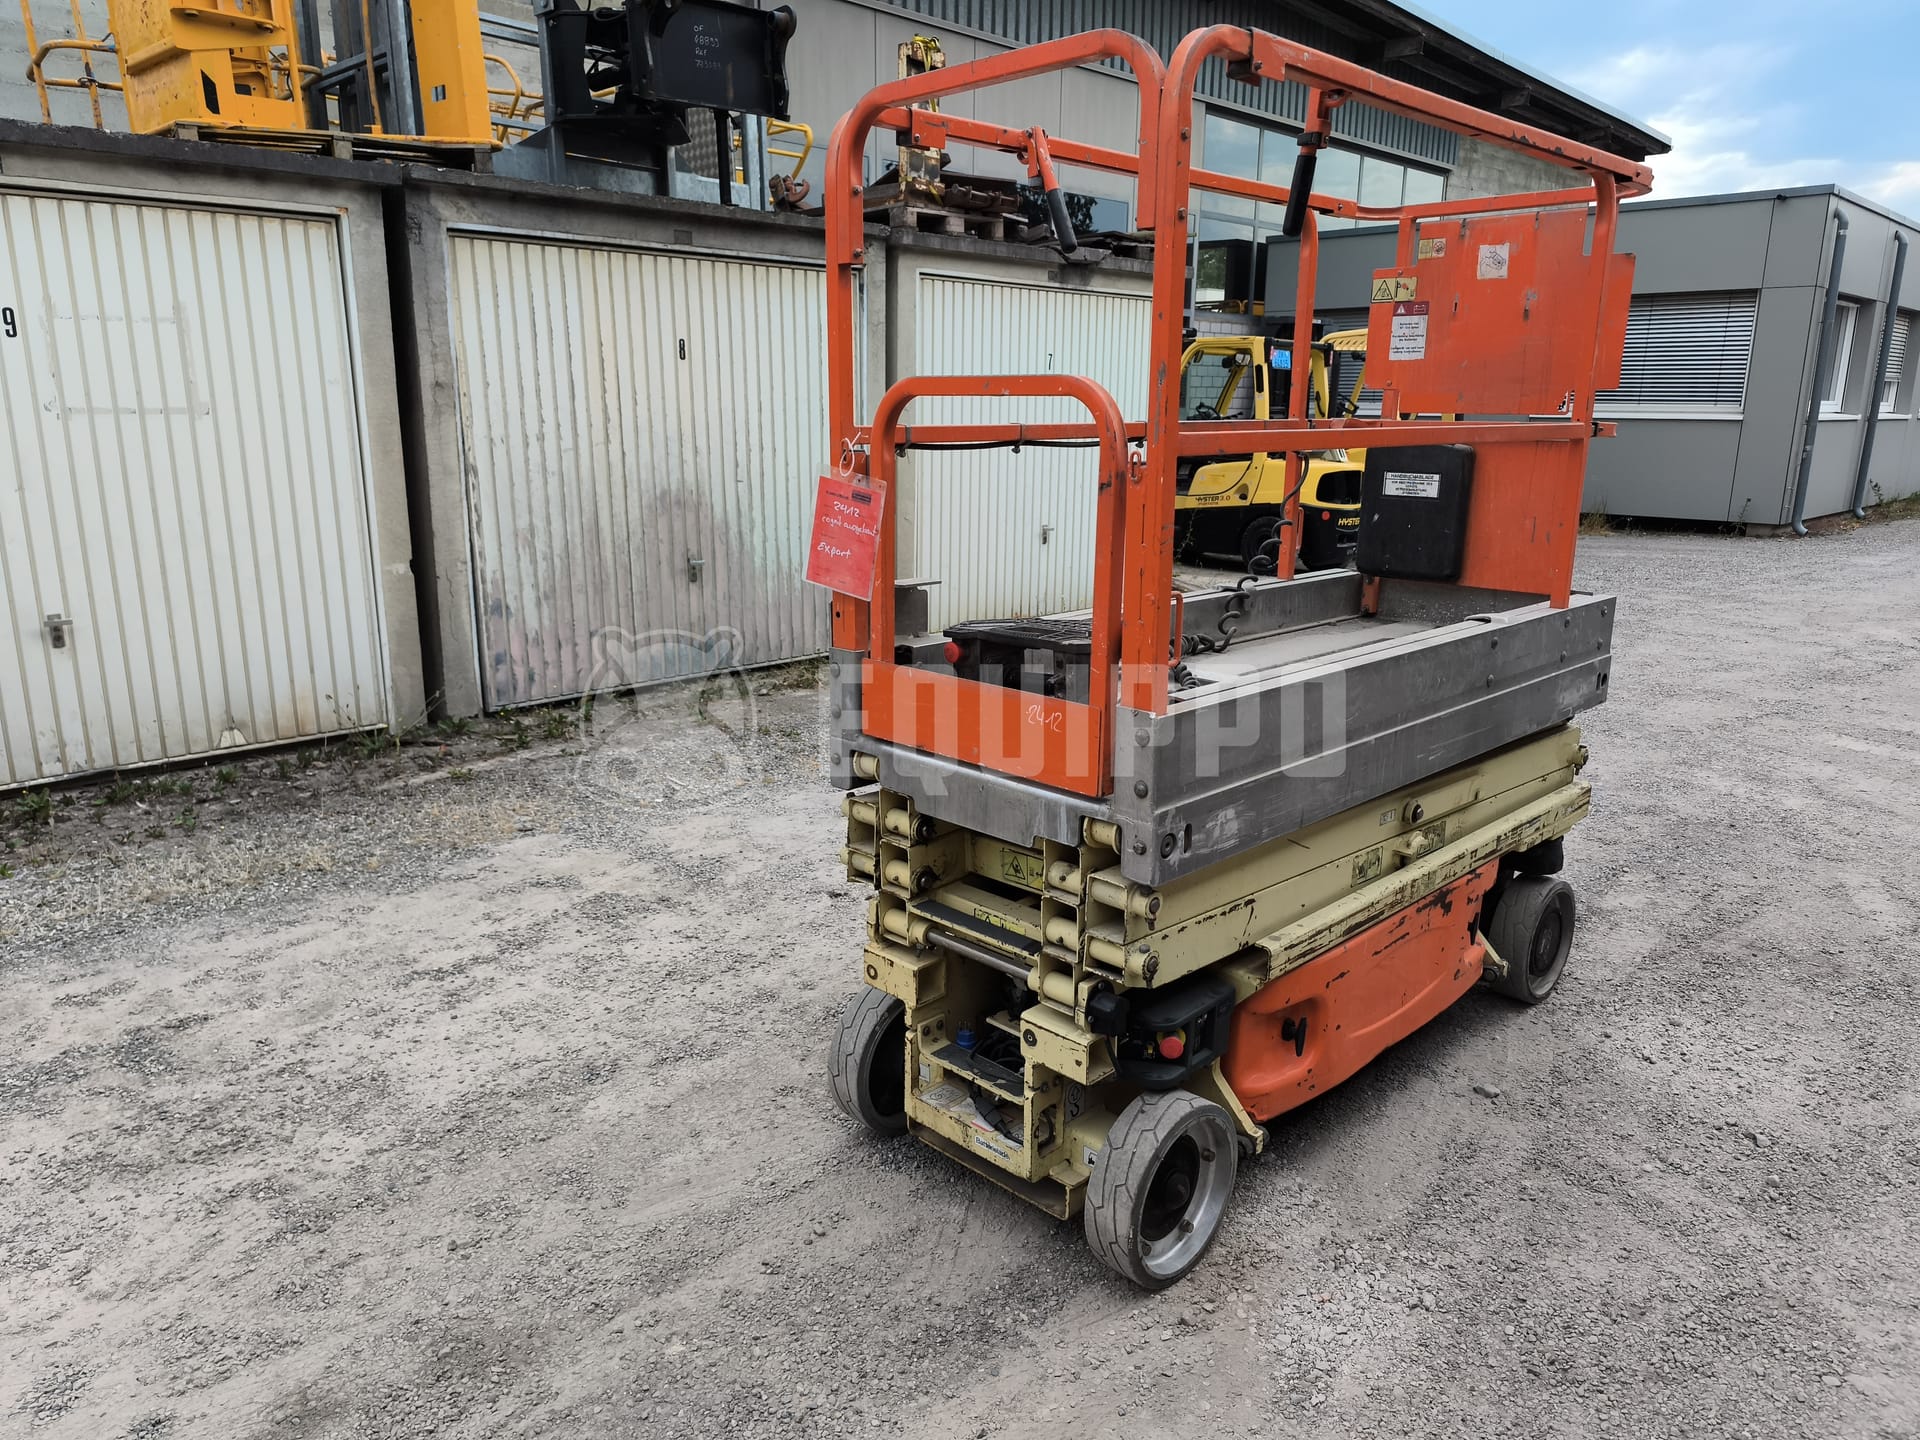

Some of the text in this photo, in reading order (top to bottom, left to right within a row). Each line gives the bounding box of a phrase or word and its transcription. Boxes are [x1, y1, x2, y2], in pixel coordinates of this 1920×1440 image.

[1, 306, 18, 338] 9
[678, 338, 686, 361] 8
[1047, 353, 1053, 371] 7
[1337, 517, 1360, 526] HYSTE
